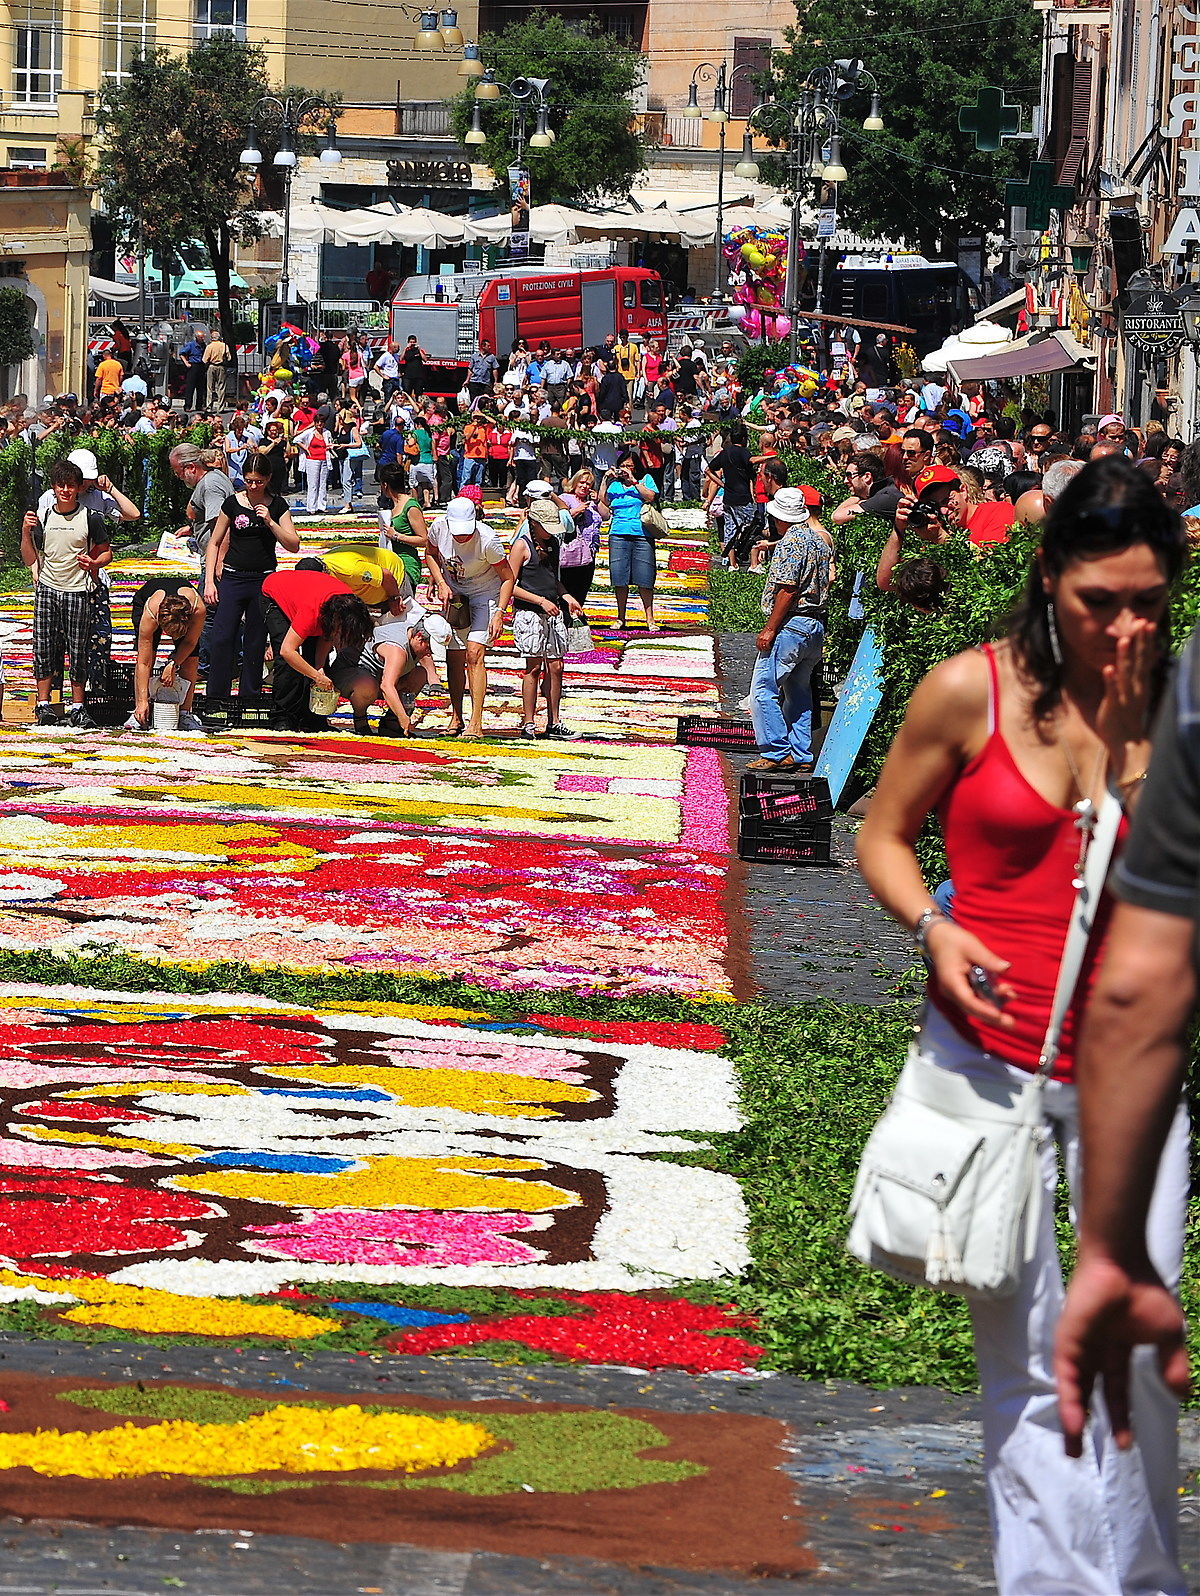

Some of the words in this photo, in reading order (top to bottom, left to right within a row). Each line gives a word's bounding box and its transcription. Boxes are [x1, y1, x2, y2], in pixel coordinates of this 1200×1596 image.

[522, 281, 556, 292] PROTEZIONE
[557, 279, 574, 288] CIVILE
[647, 317, 663, 327] ALFA
[1125, 318, 1184, 330] RISTORANTE
